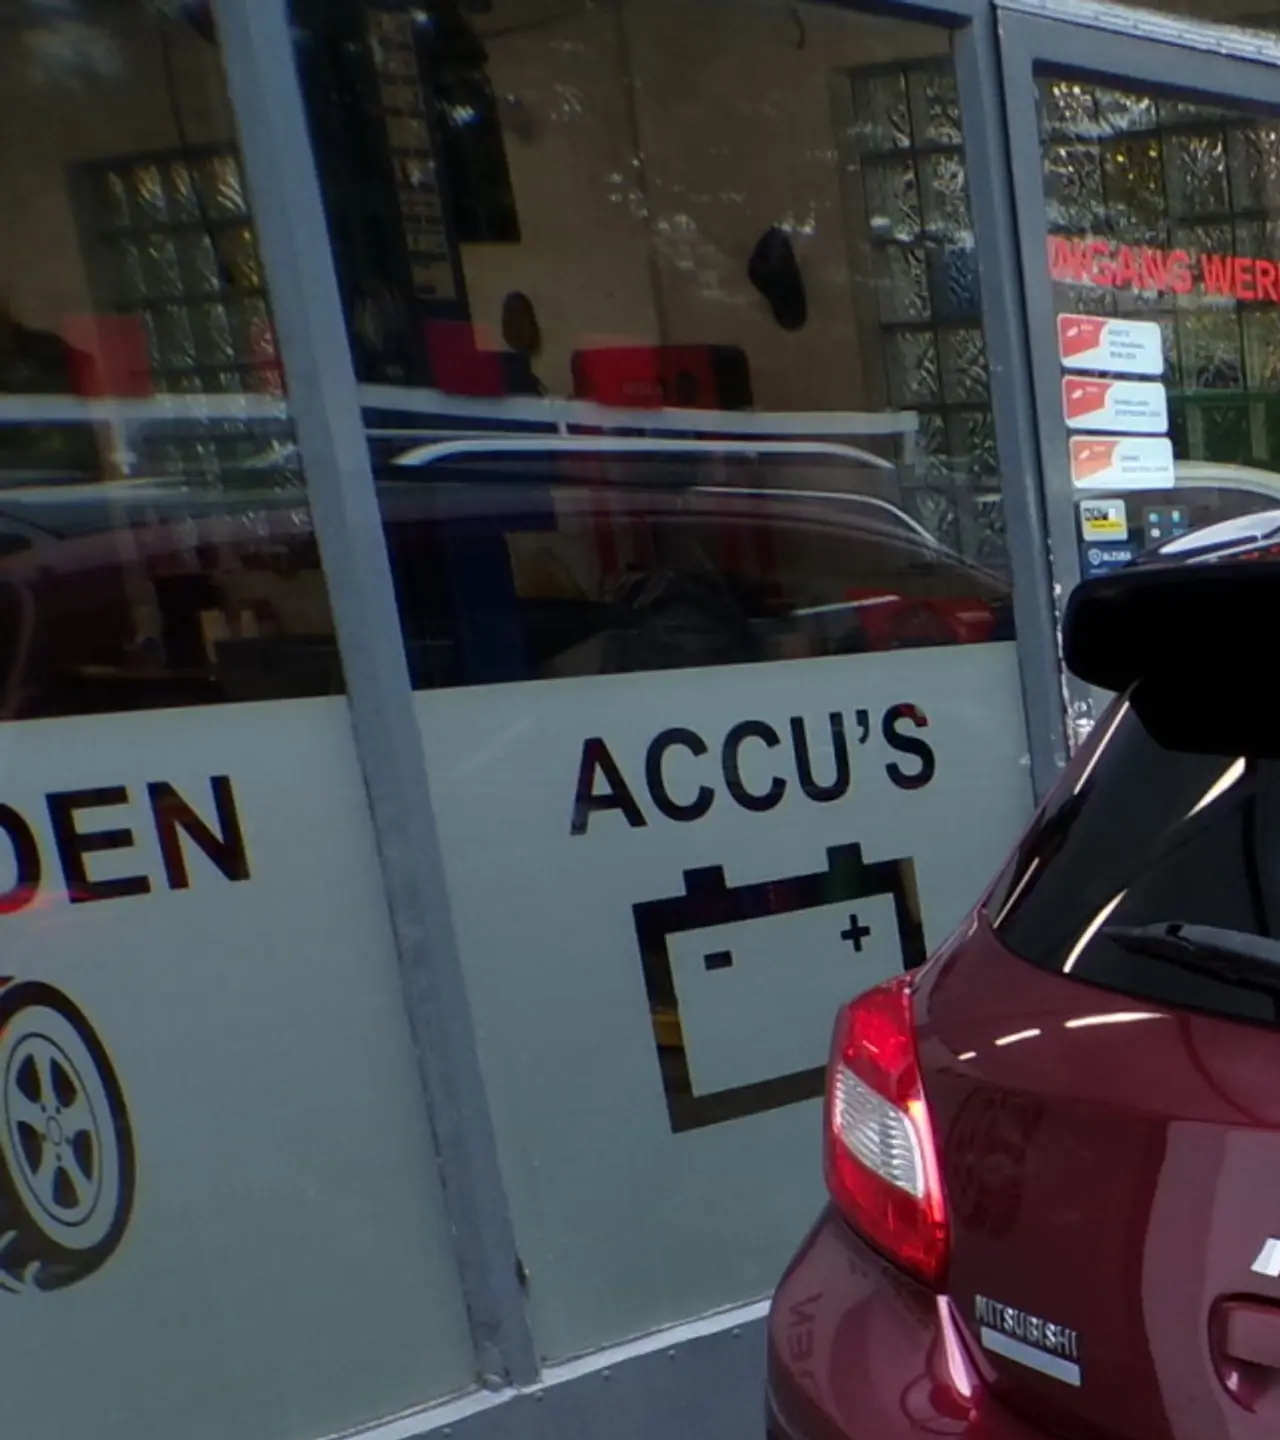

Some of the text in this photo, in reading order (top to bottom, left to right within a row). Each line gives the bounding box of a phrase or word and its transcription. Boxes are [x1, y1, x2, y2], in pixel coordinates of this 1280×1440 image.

[1047, 234, 1194, 294] INGANG
[570, 702, 935, 836] ACCU'S
[975, 1294, 1078, 1359] MITSUBISHI
